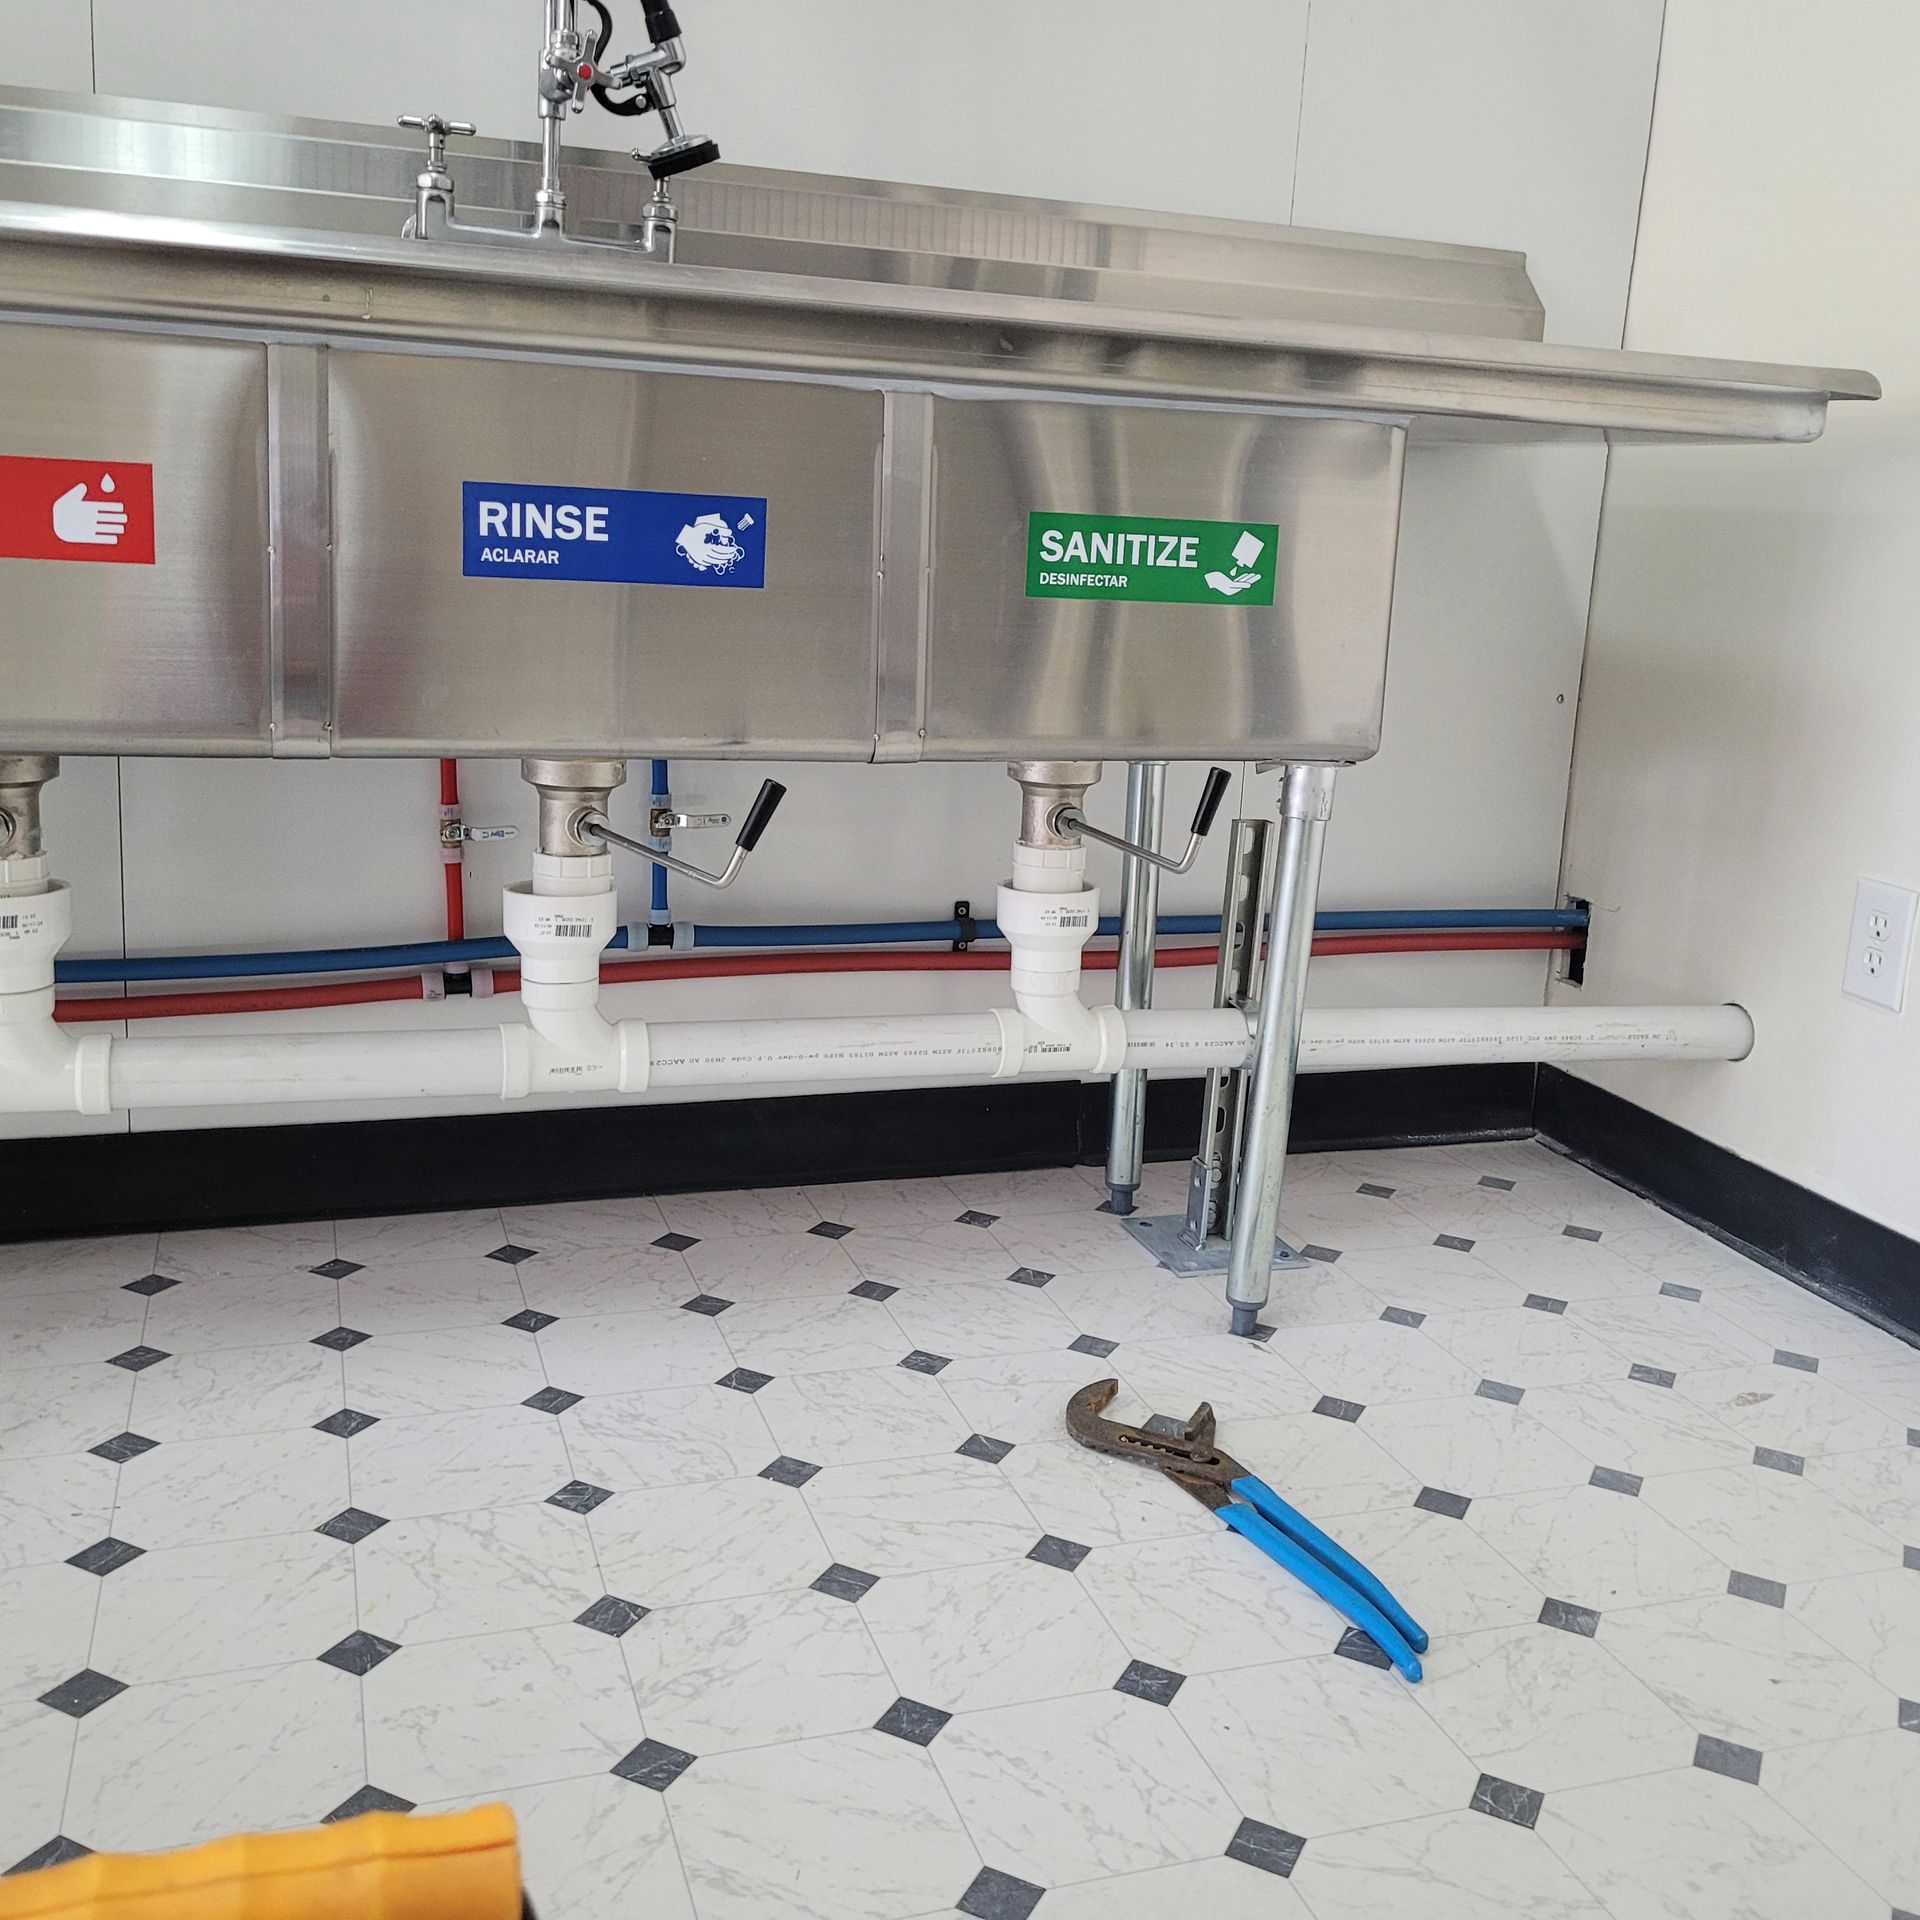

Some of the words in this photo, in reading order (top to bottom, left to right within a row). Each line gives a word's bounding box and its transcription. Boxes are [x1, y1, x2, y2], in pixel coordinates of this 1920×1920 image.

[479, 501, 609, 542] RINSE
[480, 547, 560, 565] ACLARAR
[1039, 530, 1200, 568] SANITIZE
[1039, 572, 1128, 588] DESINFECTAR
